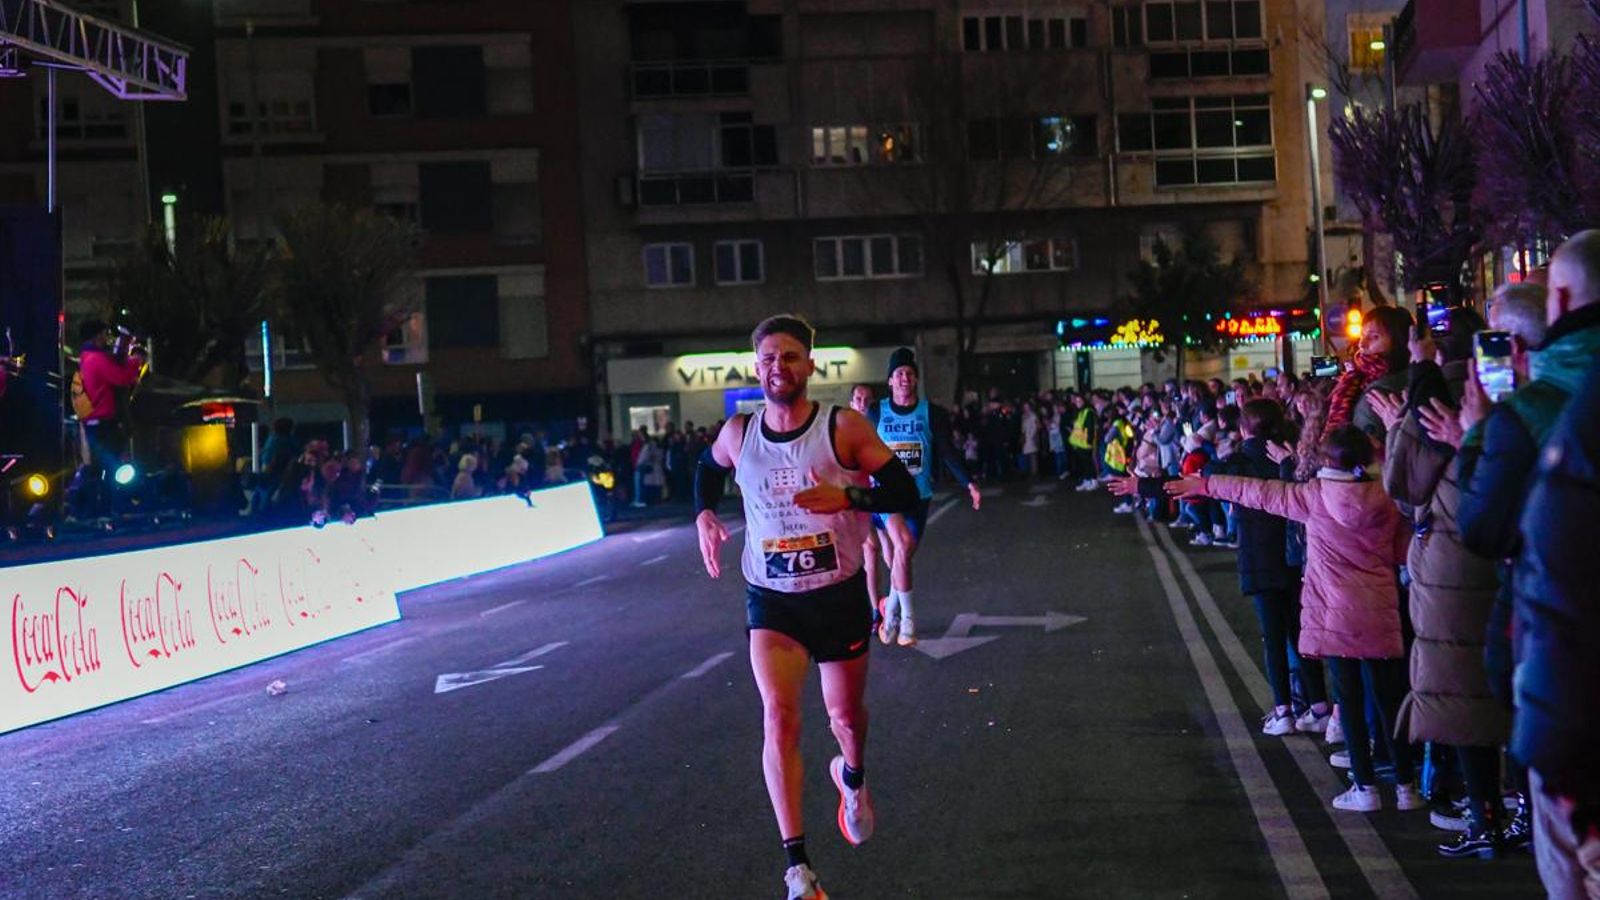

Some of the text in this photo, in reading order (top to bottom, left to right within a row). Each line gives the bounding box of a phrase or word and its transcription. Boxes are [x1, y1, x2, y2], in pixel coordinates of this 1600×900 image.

[677, 360, 848, 385] VITALNT
[884, 420, 924, 434] nerja
[782, 550, 816, 572] 76
